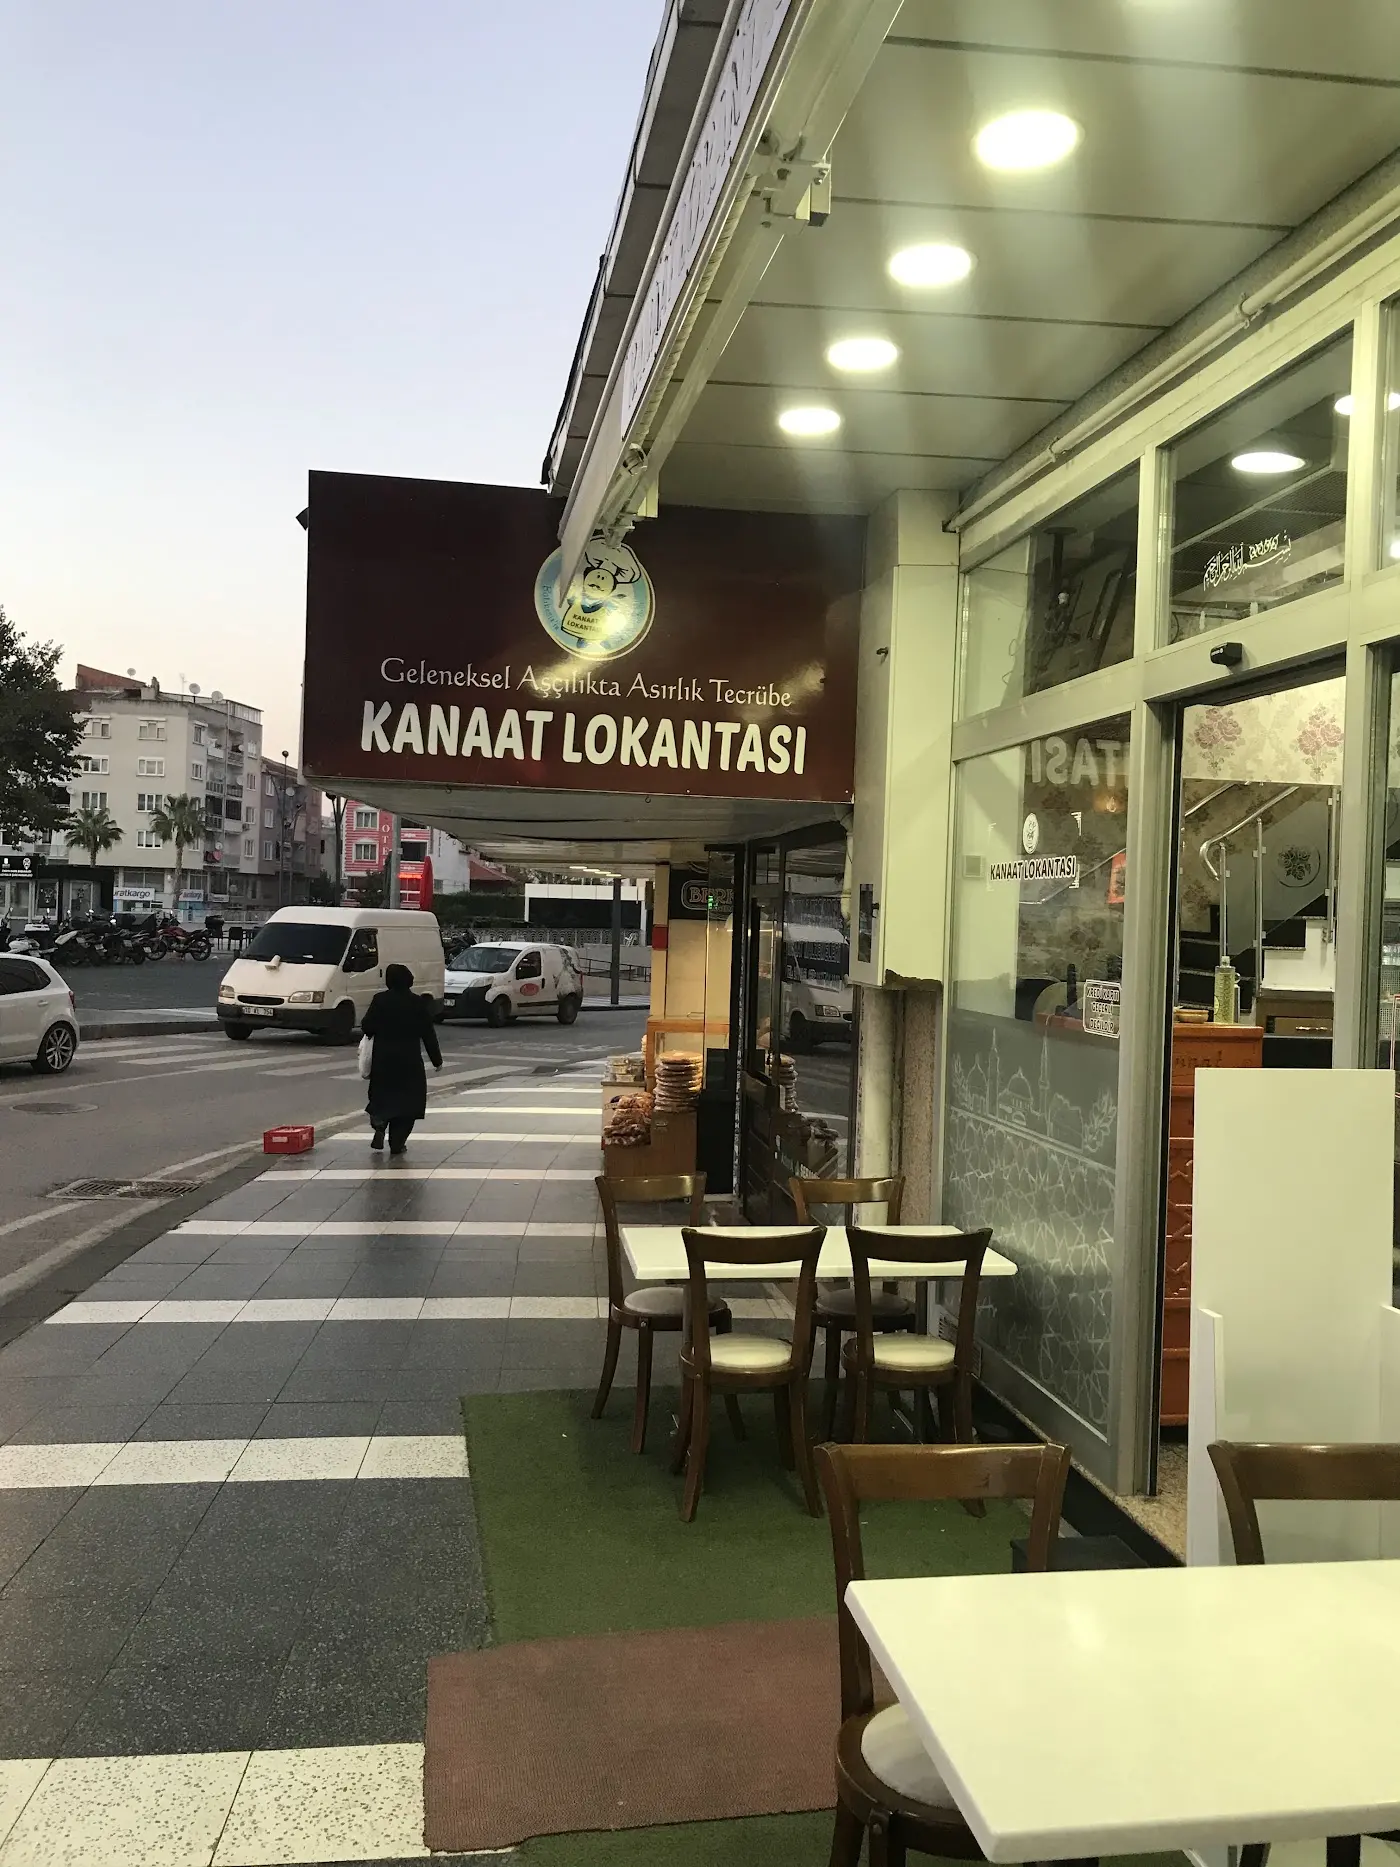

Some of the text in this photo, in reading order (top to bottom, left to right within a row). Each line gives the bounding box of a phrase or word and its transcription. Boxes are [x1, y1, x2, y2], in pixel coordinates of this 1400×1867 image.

[566, 619, 603, 633] LOKANTA
[572, 613, 600, 624] KANAAT
[380, 657, 793, 707] Geleneksel Aşçılıkta Asırlık Tecrübe
[361, 701, 807, 775] KANAAT LOKANTASI
[990, 857, 1076, 880] KANAAT LOKANTASI
